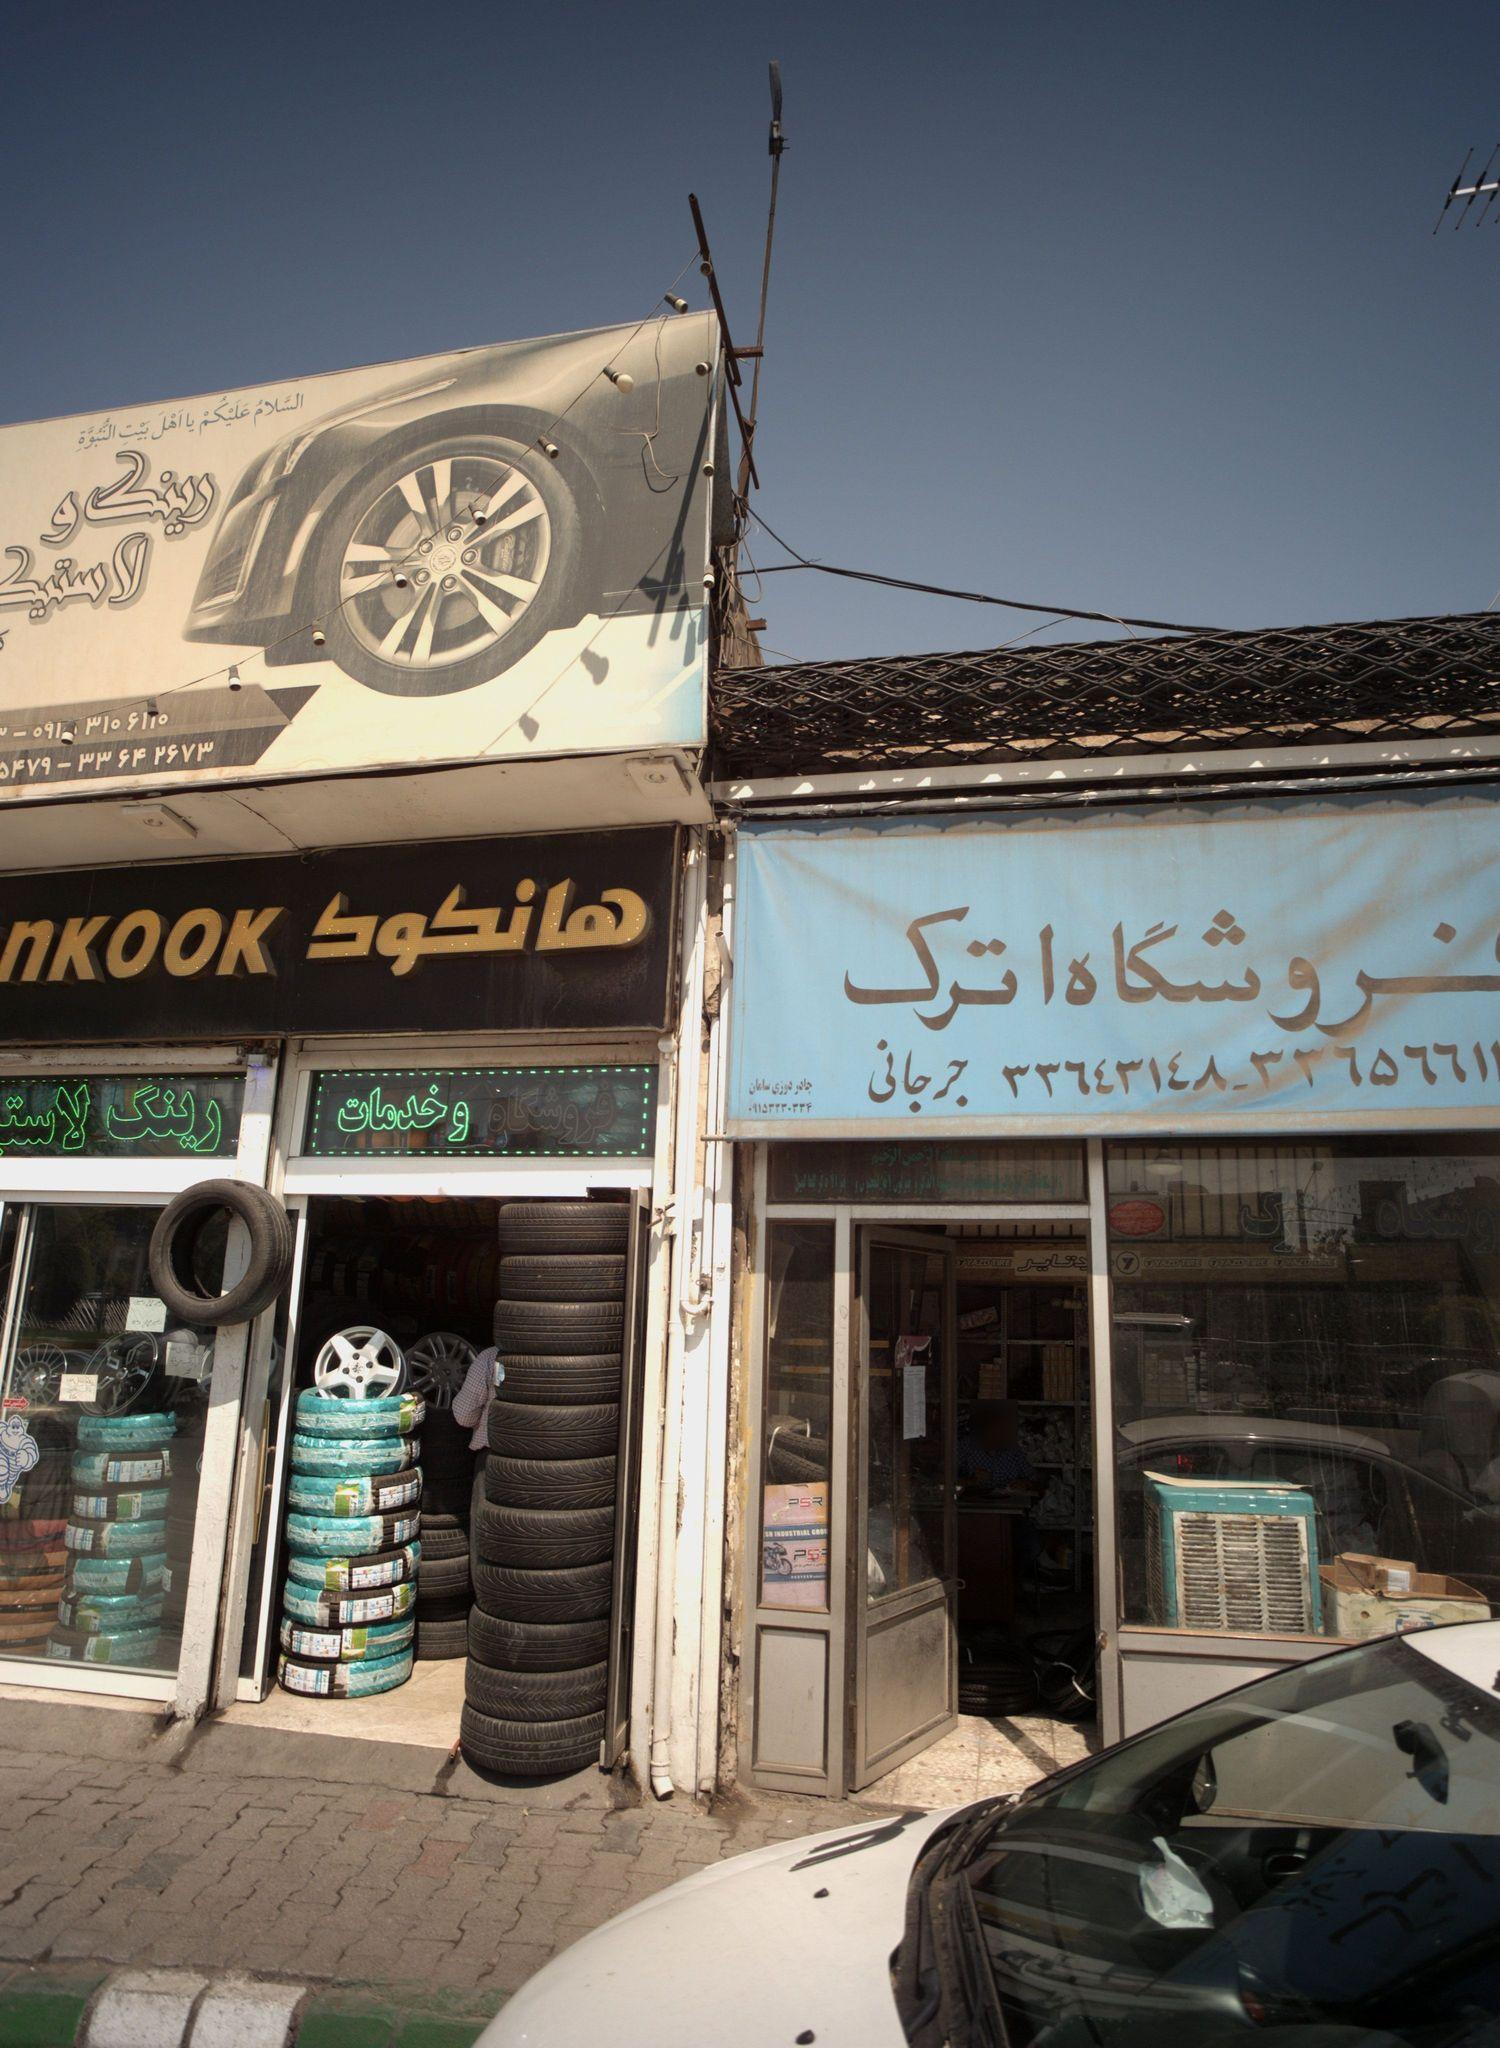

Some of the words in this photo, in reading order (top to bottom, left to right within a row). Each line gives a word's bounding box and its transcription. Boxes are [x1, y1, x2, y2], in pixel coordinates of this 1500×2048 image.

[39, 490, 80, 545] و
[33, 721, 77, 740] ۰۹۱
[306, 877, 654, 977] هانکوک
[843, 905, 1055, 1030] اترک
[868, 1038, 969, 1112] جرجانی
[107, 1084, 223, 1152] رینگ
